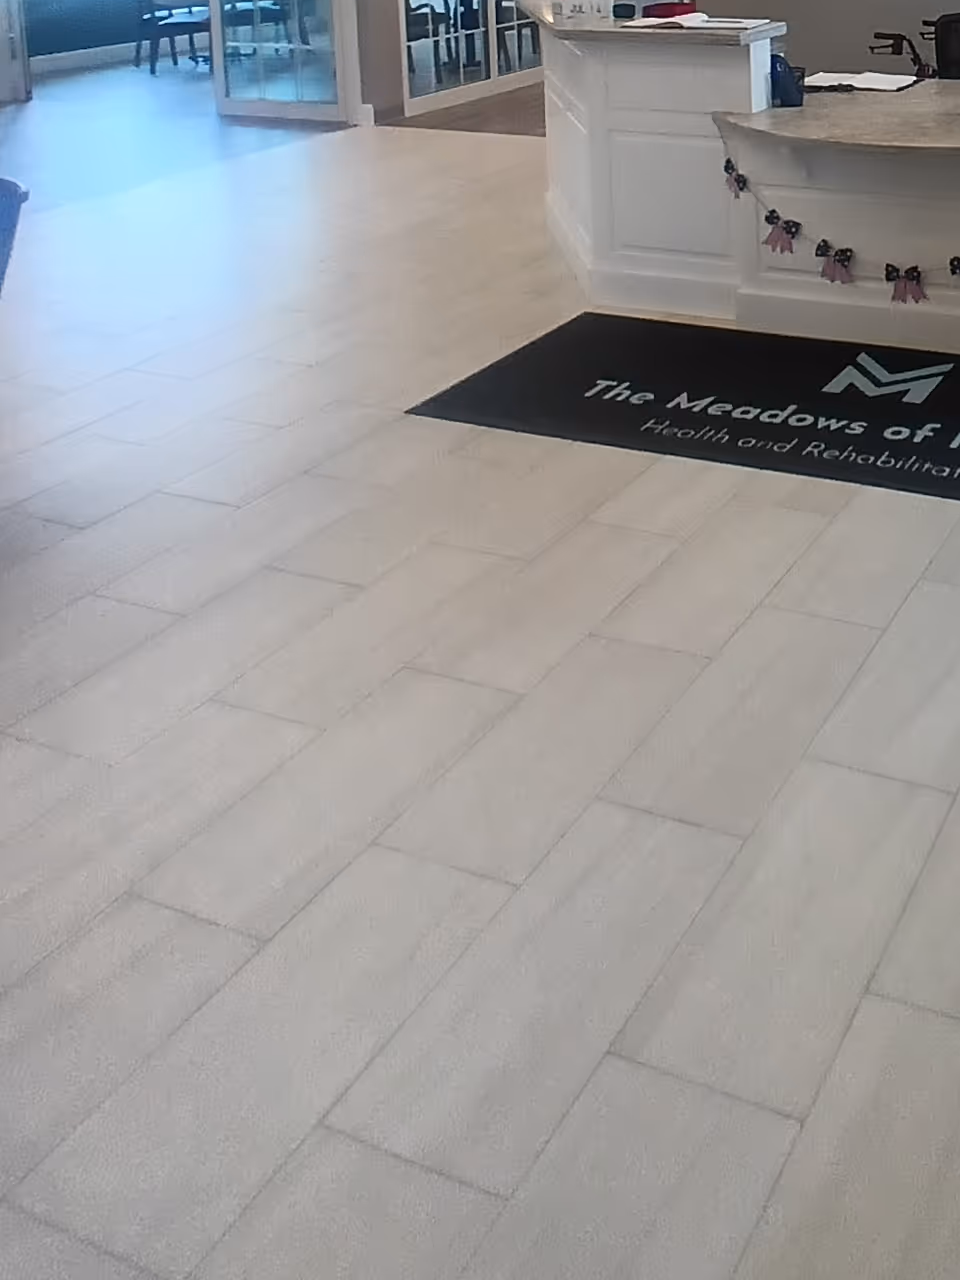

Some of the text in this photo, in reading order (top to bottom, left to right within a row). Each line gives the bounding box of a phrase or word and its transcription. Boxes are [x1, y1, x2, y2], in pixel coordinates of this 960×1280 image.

[584, 380, 655, 405] The
[665, 391, 869, 436] Meadows
[882, 423, 942, 444] of
[639, 417, 730, 444] Health
[737, 437, 798, 453] and
